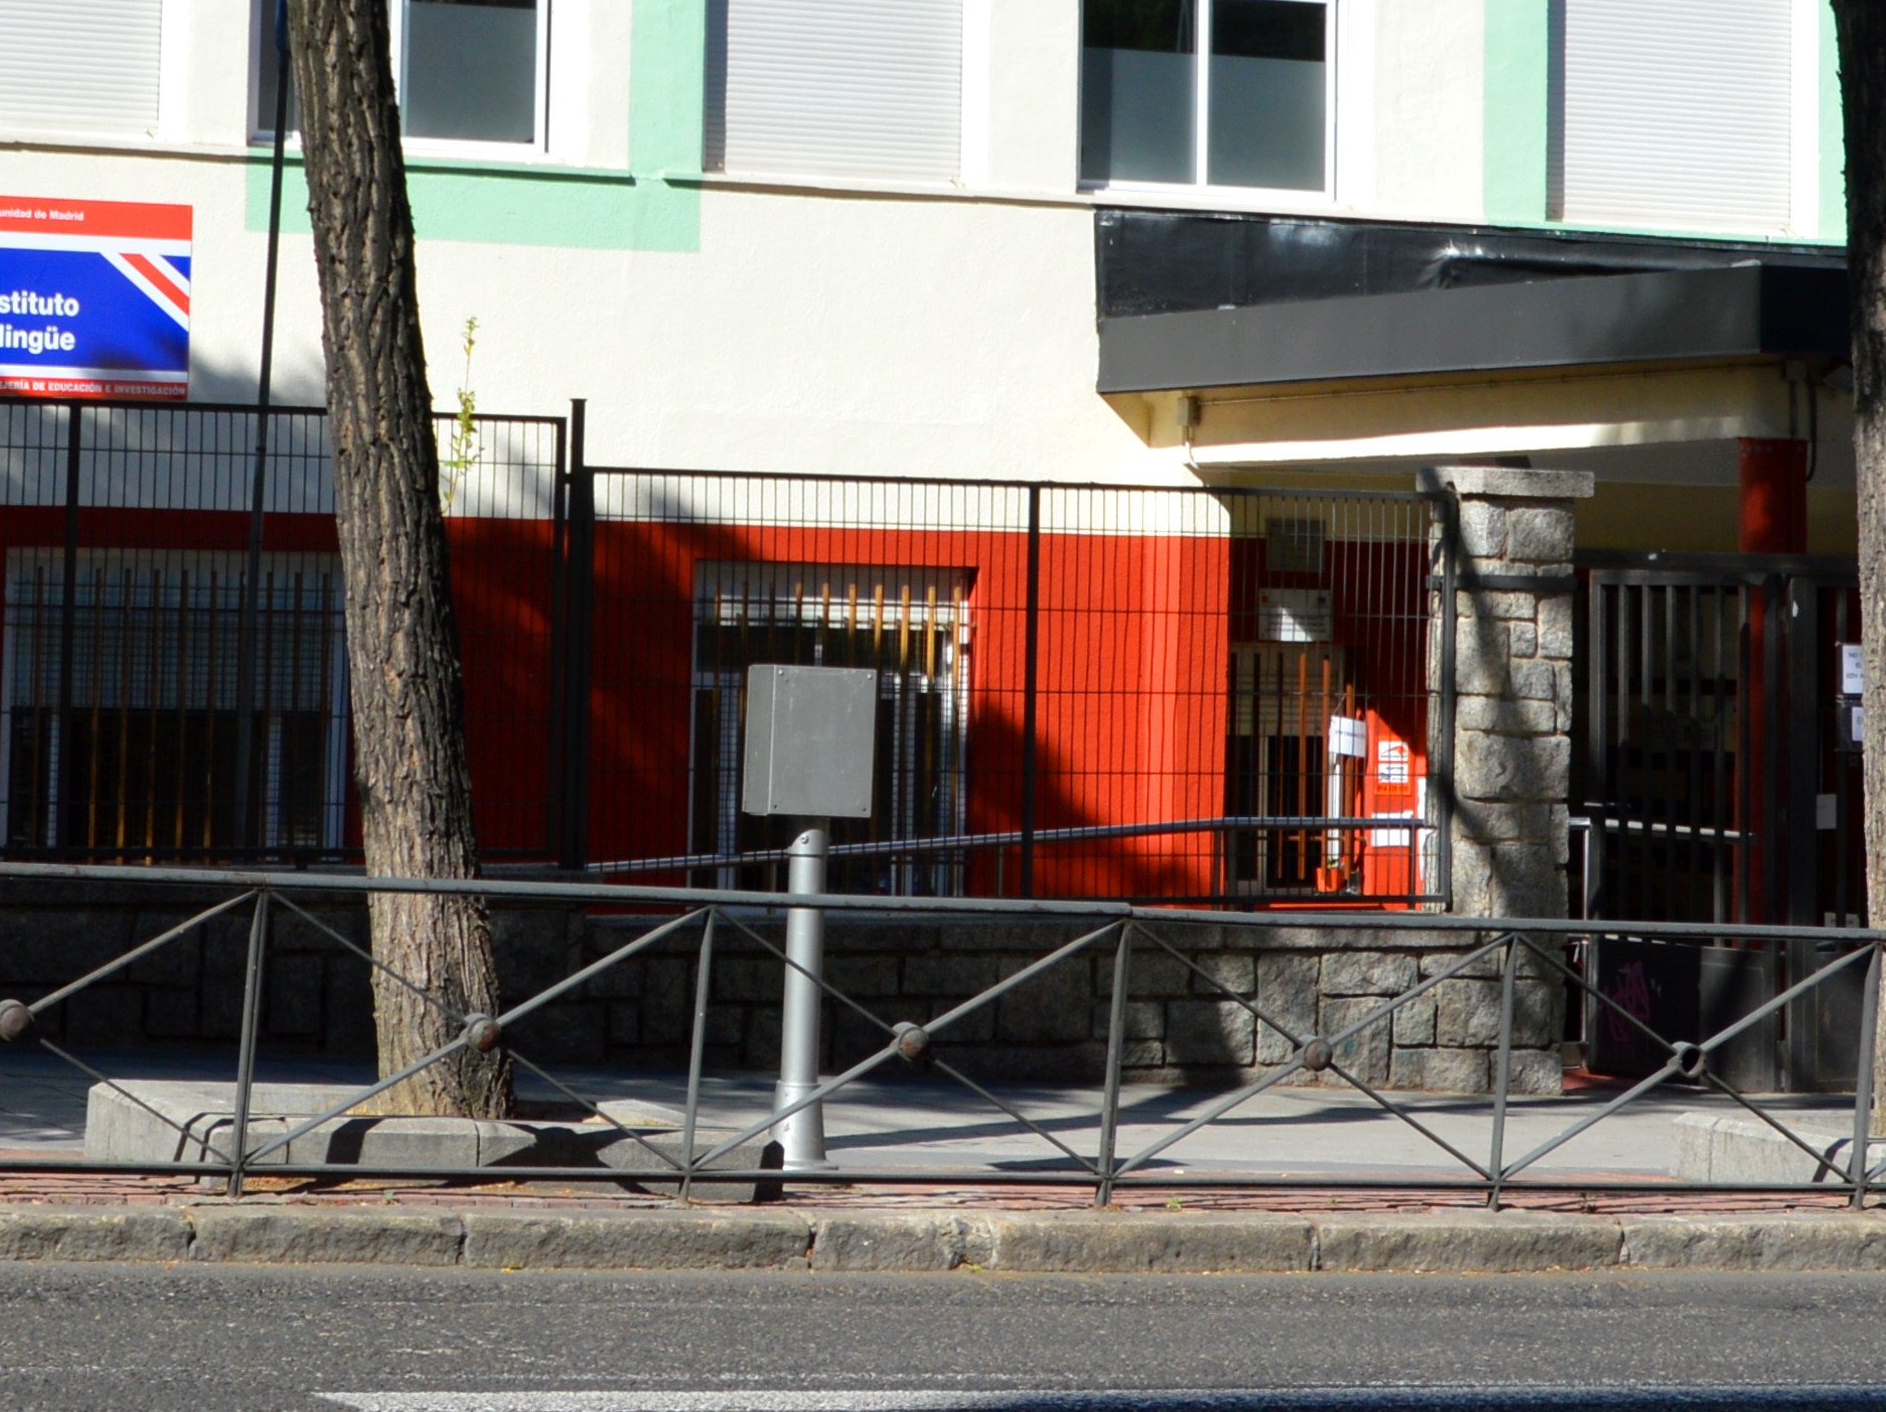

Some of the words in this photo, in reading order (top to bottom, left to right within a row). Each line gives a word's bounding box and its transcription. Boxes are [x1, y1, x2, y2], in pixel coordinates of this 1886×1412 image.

[34, 209, 47, 220] de
[49, 210, 84, 221] Madrid
[32, 382, 45, 391] DE
[48, 381, 102, 393] EDUCACIÓN
